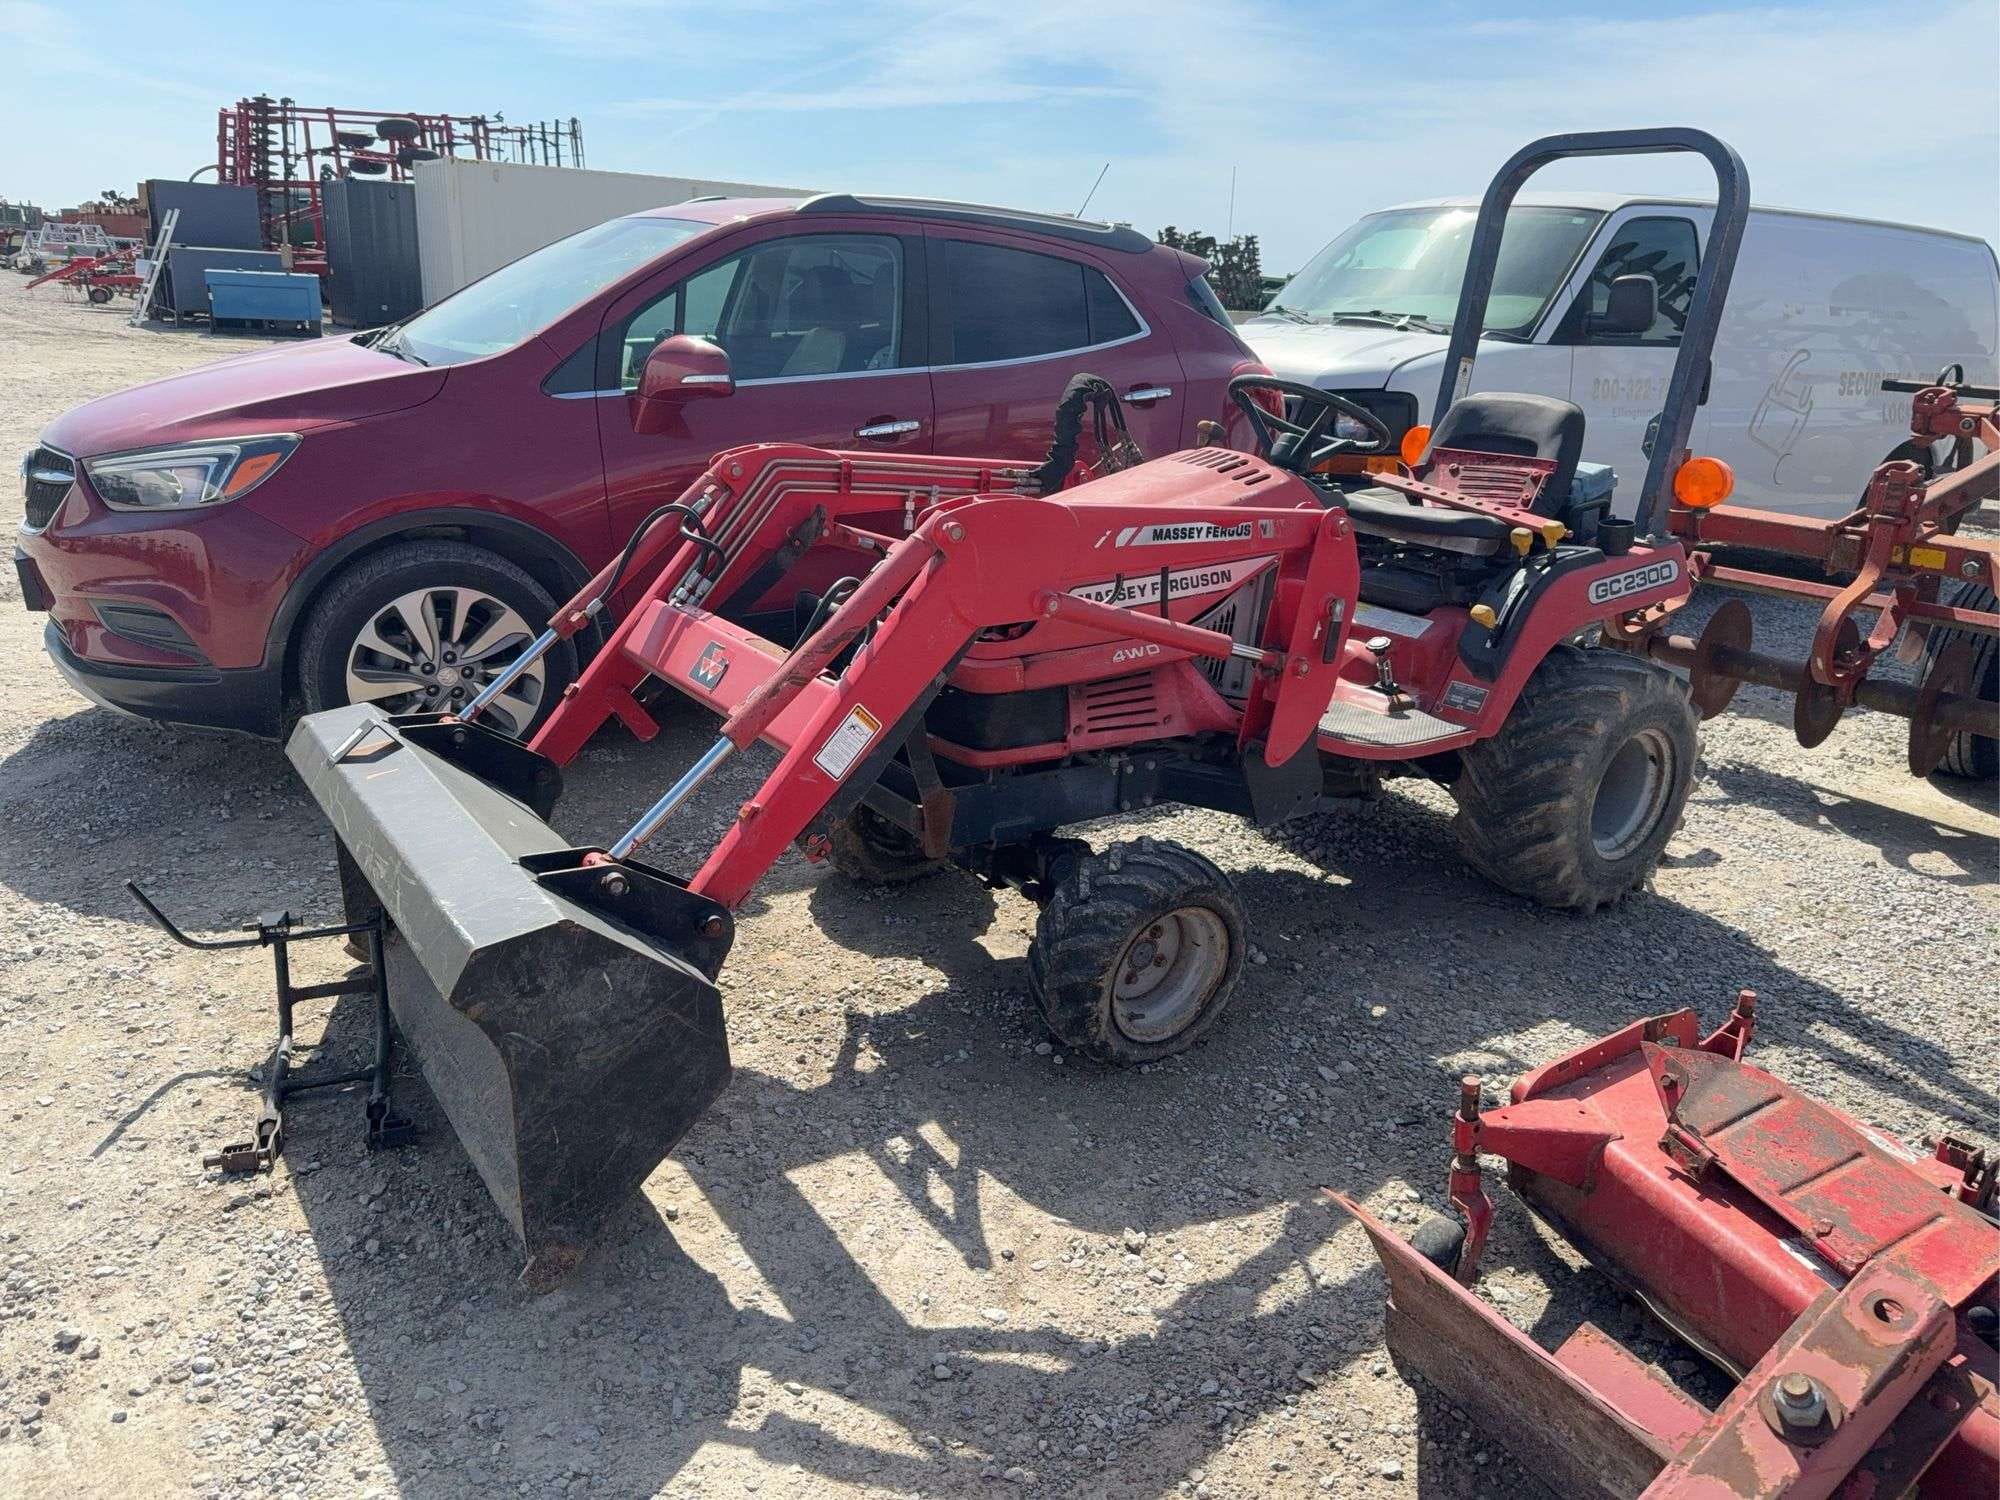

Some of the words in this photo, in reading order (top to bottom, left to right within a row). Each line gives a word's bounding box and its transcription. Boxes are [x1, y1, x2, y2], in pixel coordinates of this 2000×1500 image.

[1152, 526, 1203, 541] MASSEY
[1205, 523, 1268, 538] FERGUS
[1151, 569, 1232, 595] FRGUSON
[1595, 563, 1673, 600] GC2300
[1112, 643, 1161, 663] 4WD
